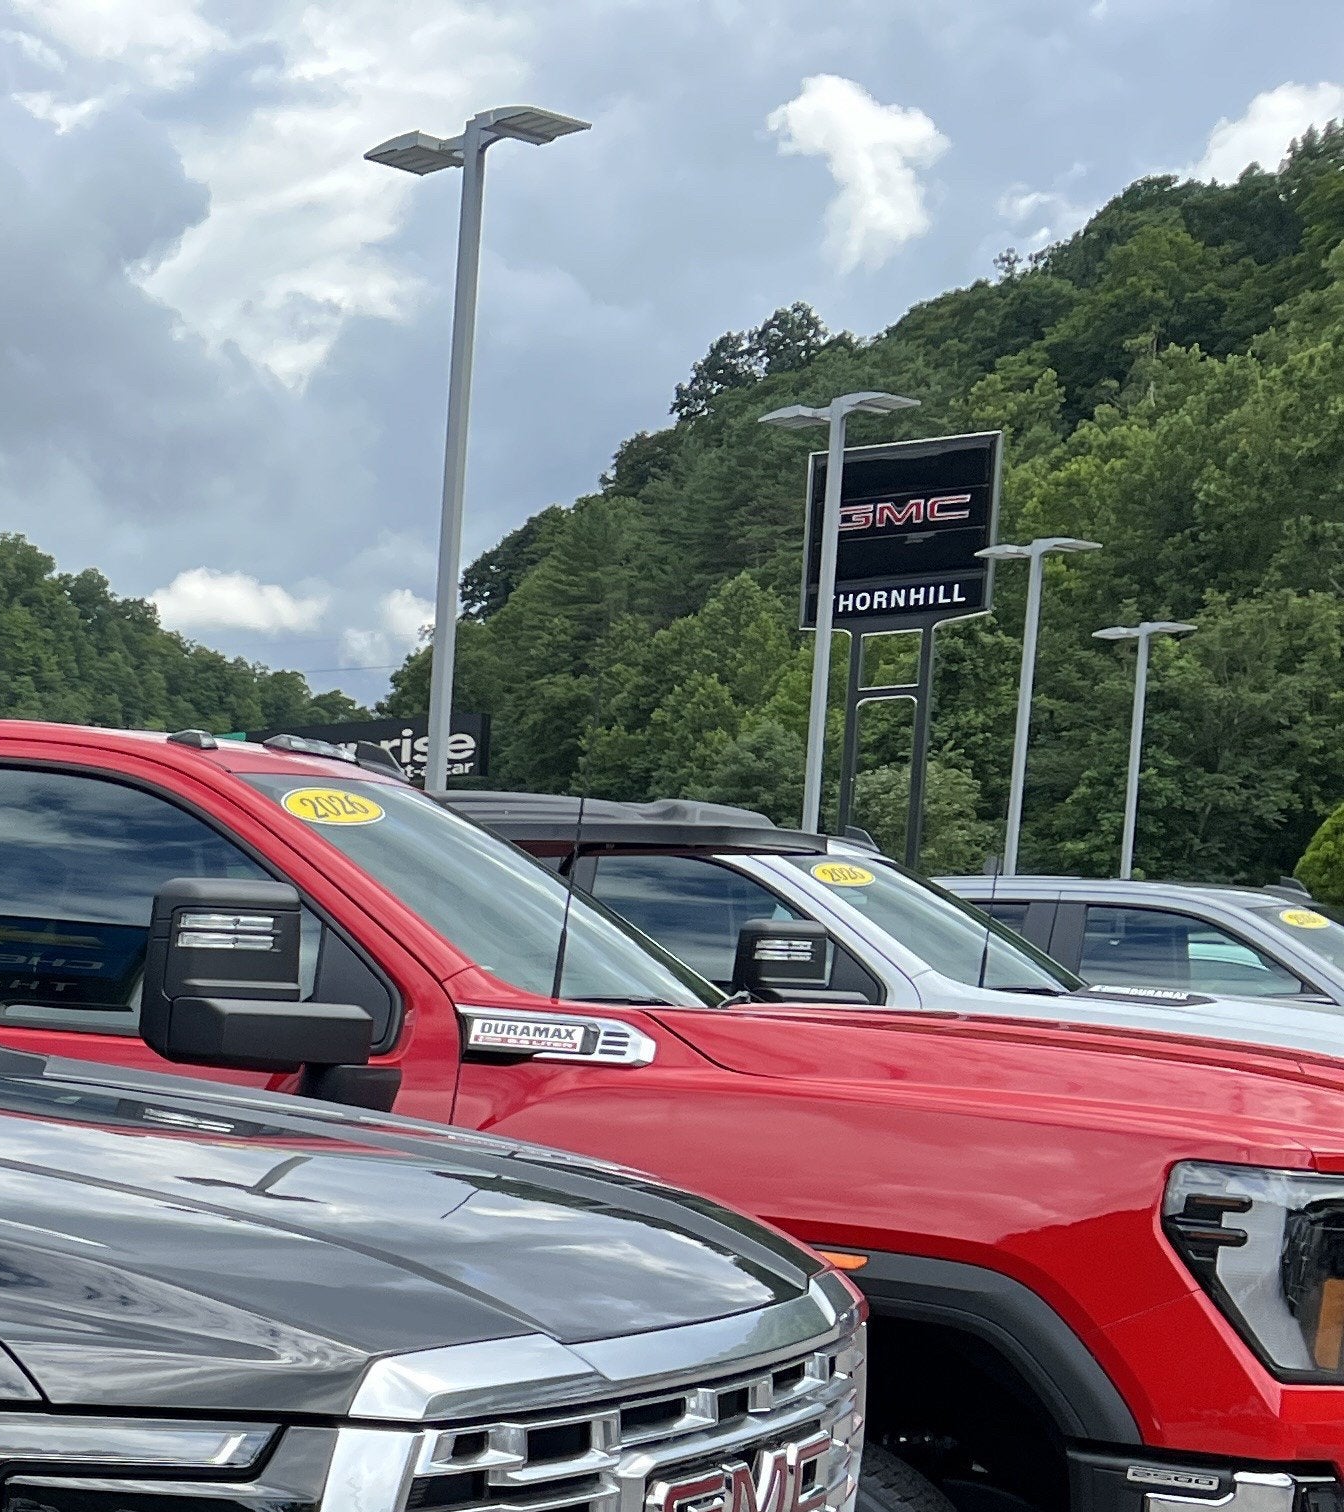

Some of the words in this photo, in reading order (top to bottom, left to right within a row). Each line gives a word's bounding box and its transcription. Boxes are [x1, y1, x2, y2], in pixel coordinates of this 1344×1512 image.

[838, 493, 972, 533] GMC
[833, 583, 967, 613] HORNHILL
[299, 794, 370, 819] 2026
[479, 1021, 577, 1041] DURAMAX
[1132, 1470, 1214, 1486] 2500
